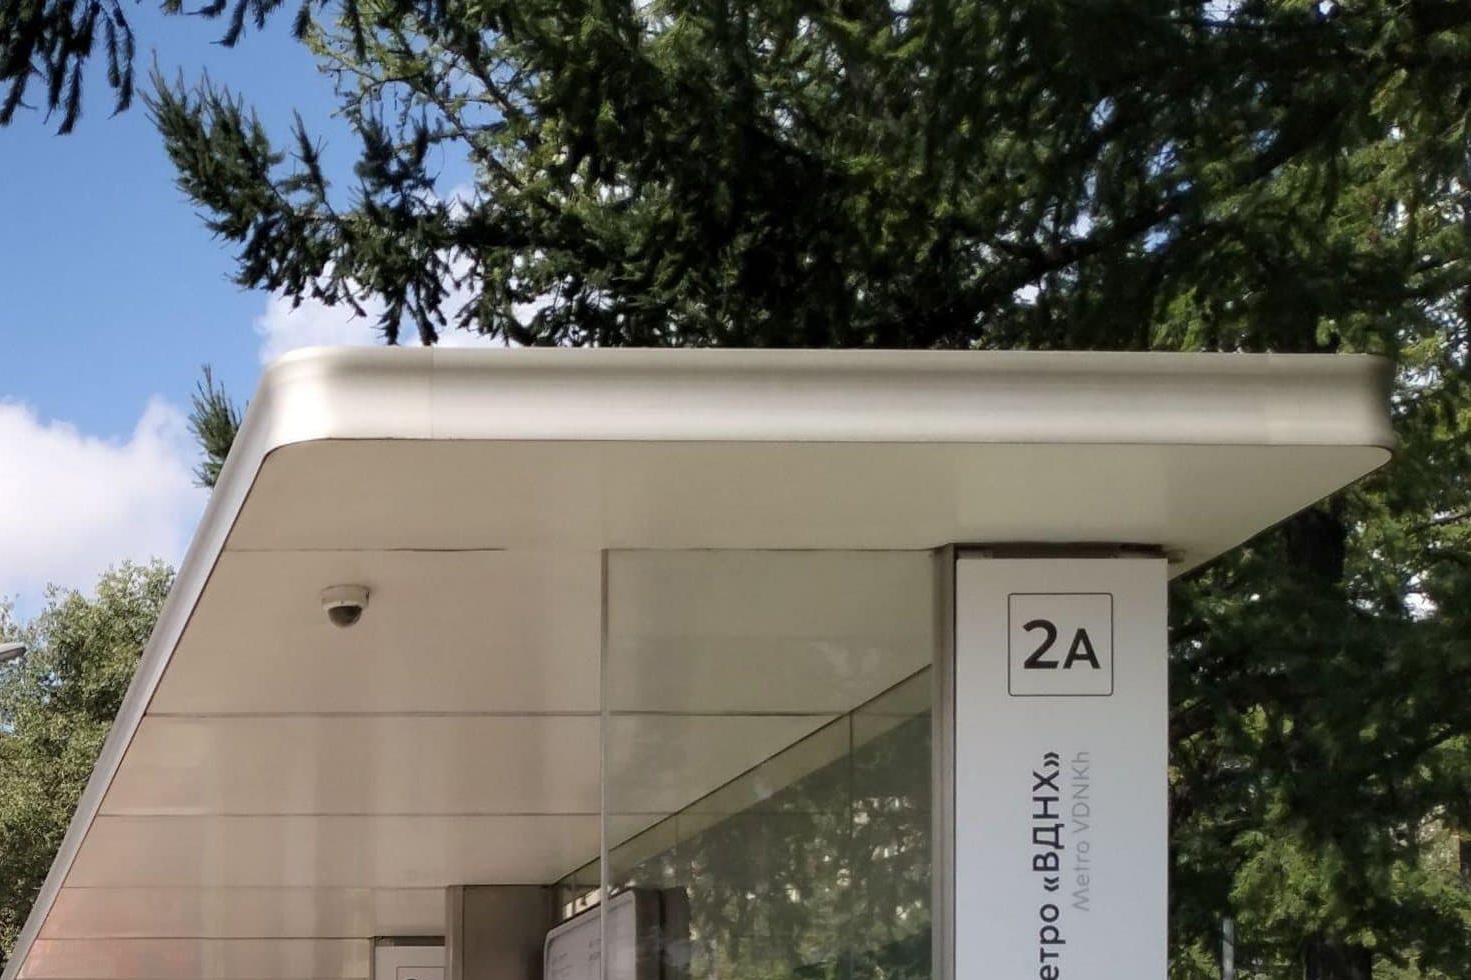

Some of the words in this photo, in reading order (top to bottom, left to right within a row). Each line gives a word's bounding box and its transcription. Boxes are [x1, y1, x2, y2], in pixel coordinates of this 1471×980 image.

[1022, 618, 1101, 670] 2А
[1032, 751, 1065, 892] «ВДНХ»
[1072, 751, 1091, 832] VDNKh
[1072, 839, 1091, 912] Metro
